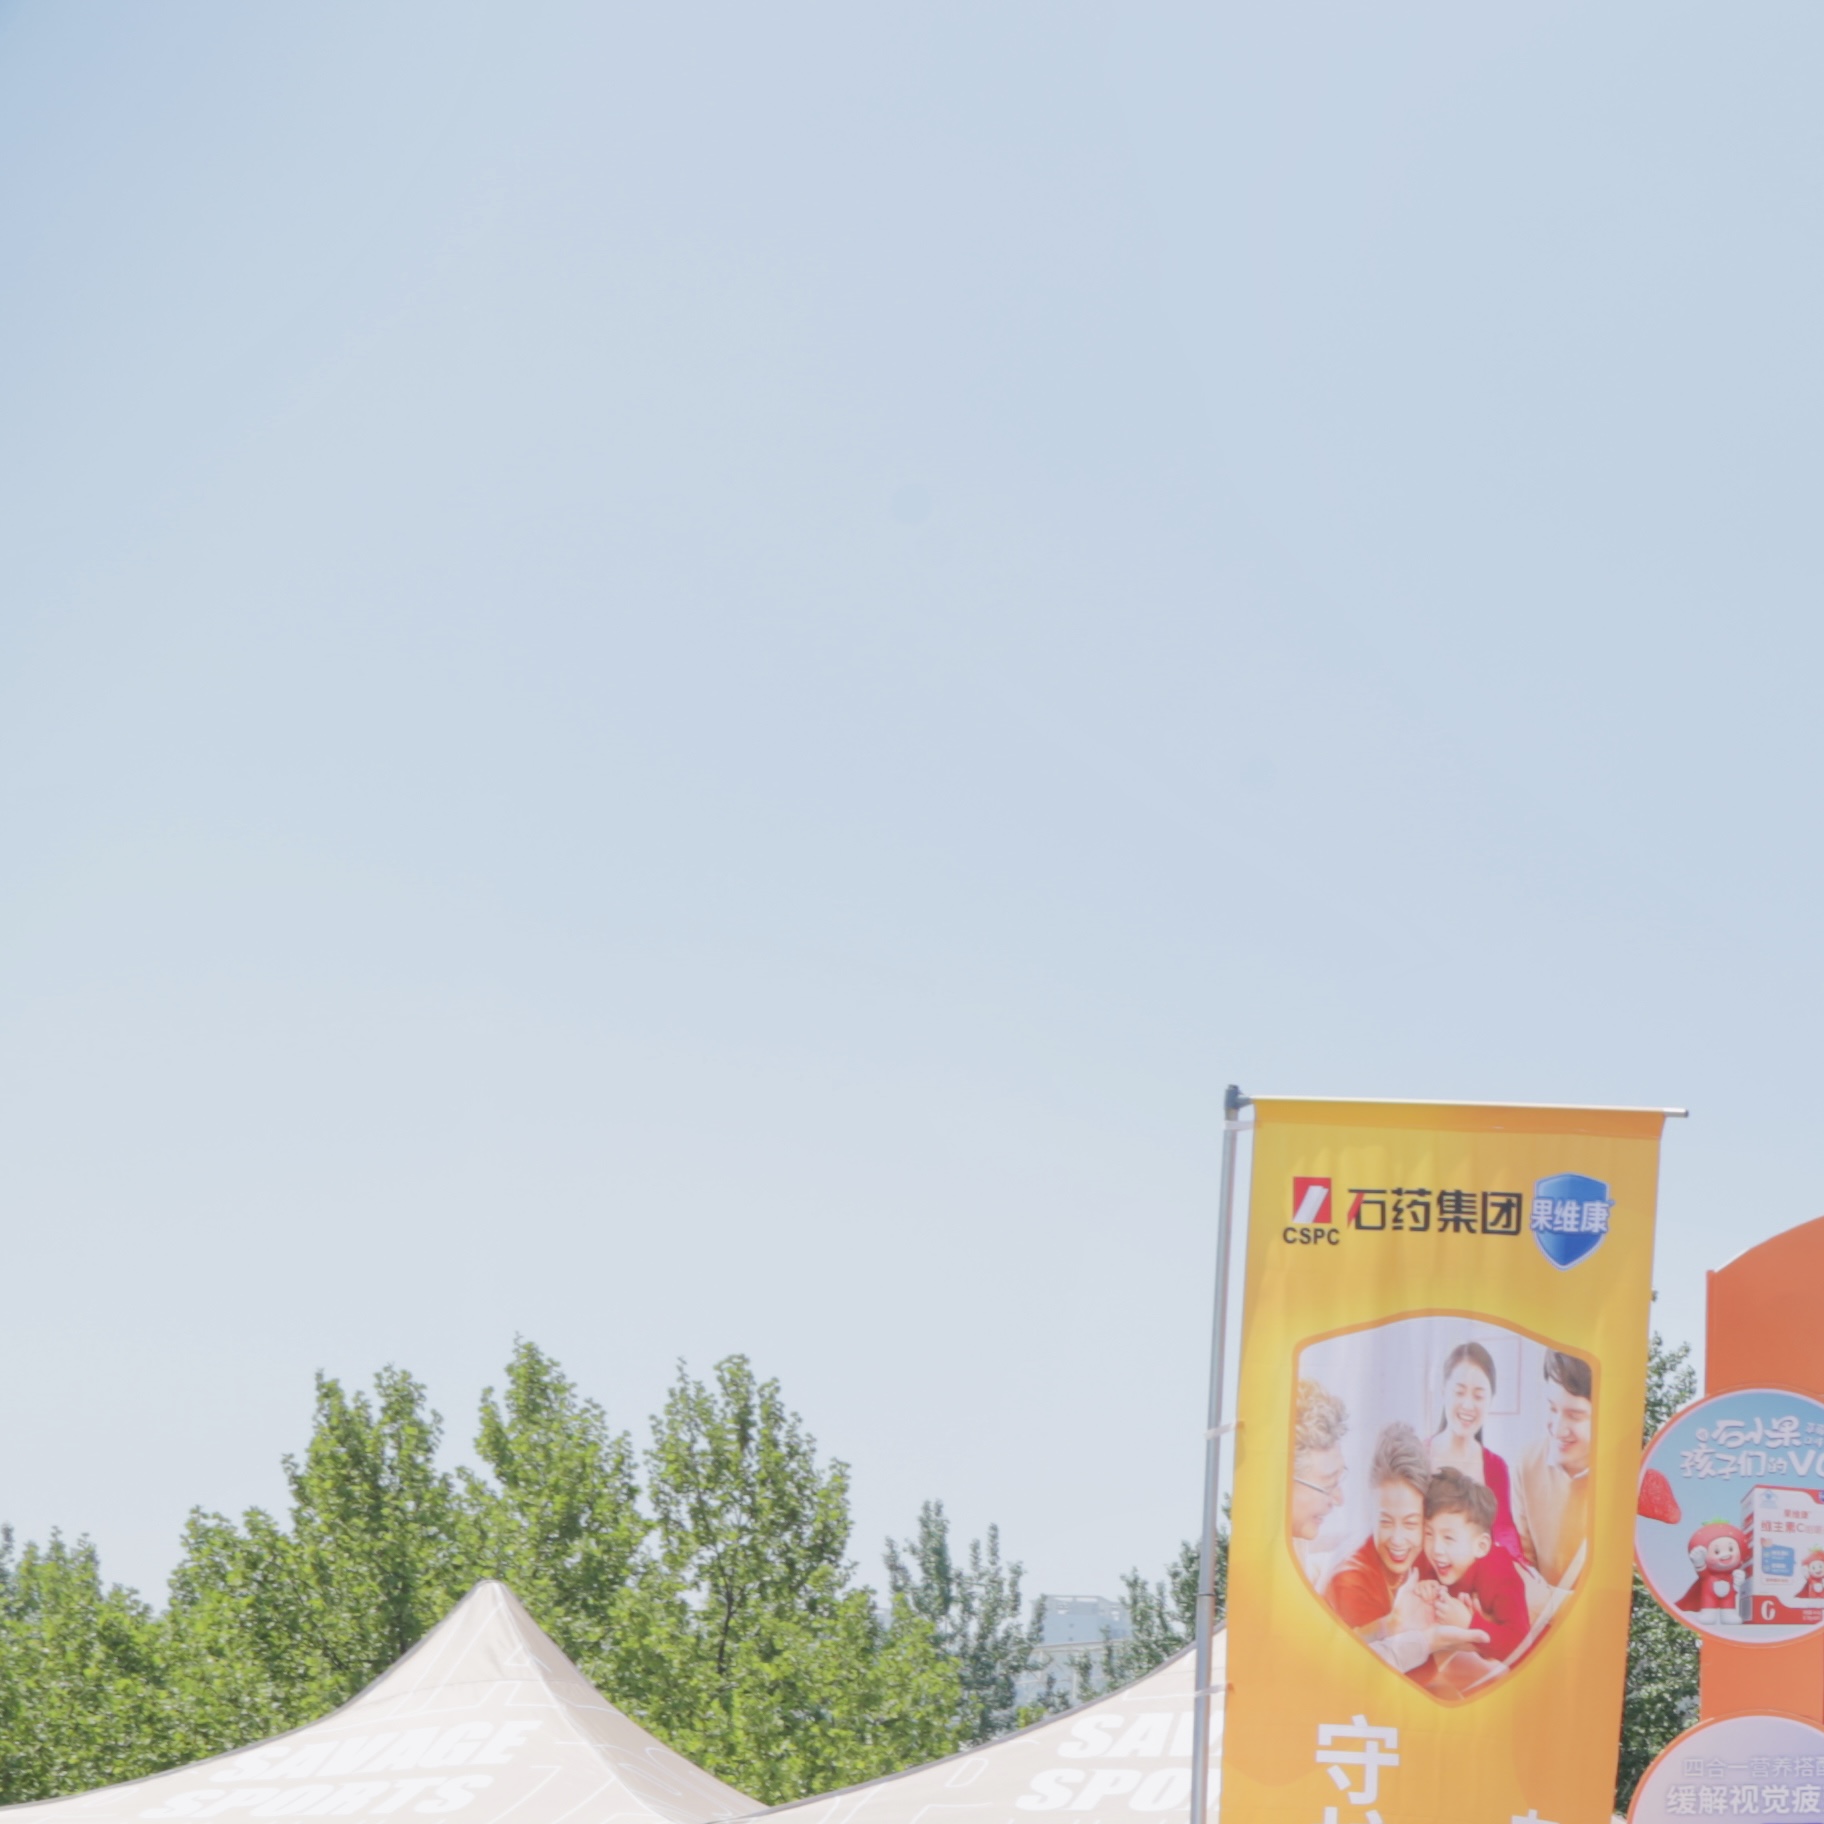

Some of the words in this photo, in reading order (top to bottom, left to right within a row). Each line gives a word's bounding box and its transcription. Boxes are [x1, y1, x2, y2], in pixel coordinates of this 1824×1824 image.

[1347, 1189, 1523, 1236] 石药集团
[1530, 1198, 1610, 1234] 果维康
[1283, 1227, 1340, 1246] CSPC
[1712, 1416, 1801, 1449] 石小果
[210, 1720, 542, 1783] SAVAGE
[139, 1774, 494, 1820] SPORTS
